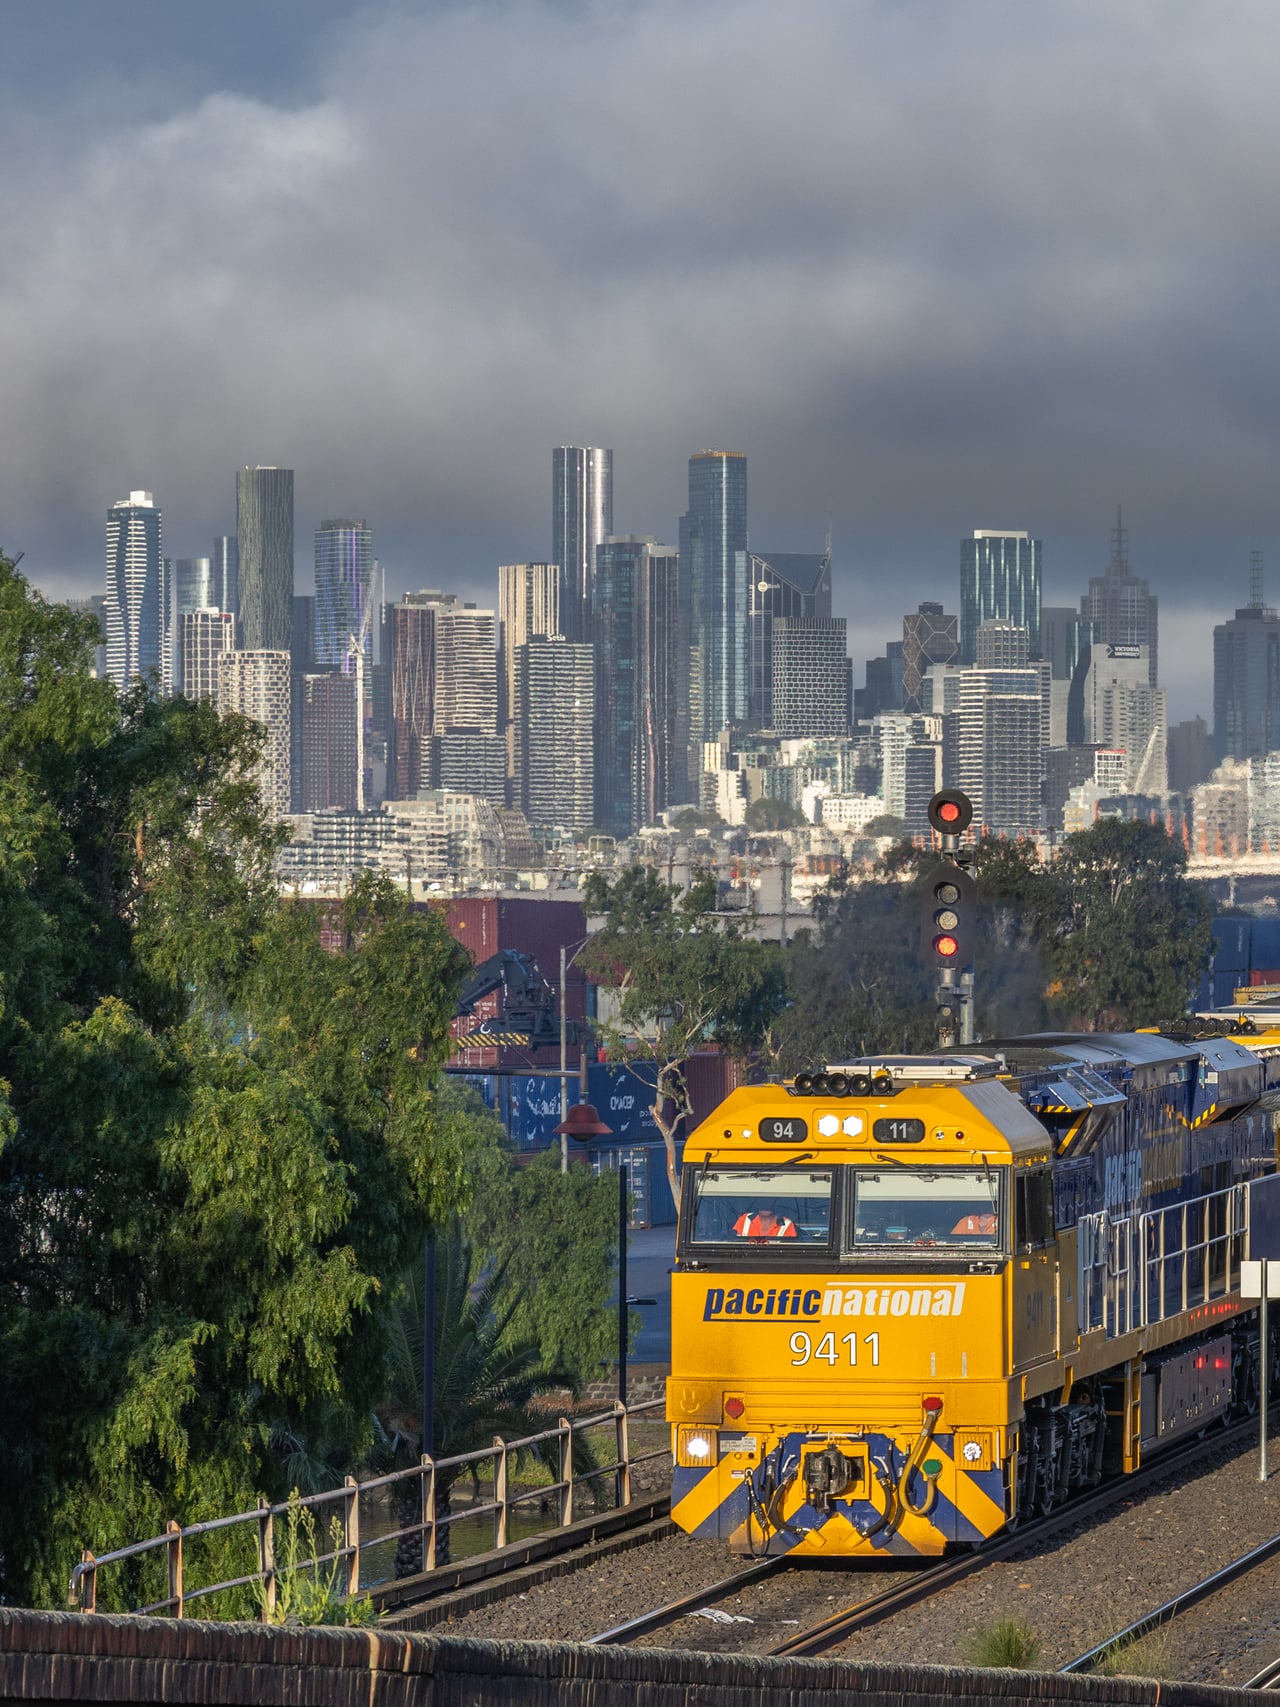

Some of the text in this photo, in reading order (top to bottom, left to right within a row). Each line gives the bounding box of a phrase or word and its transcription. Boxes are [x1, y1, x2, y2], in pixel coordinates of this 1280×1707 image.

[773, 1122, 908, 1139] 94 11
[788, 1331, 881, 1367] 9411
